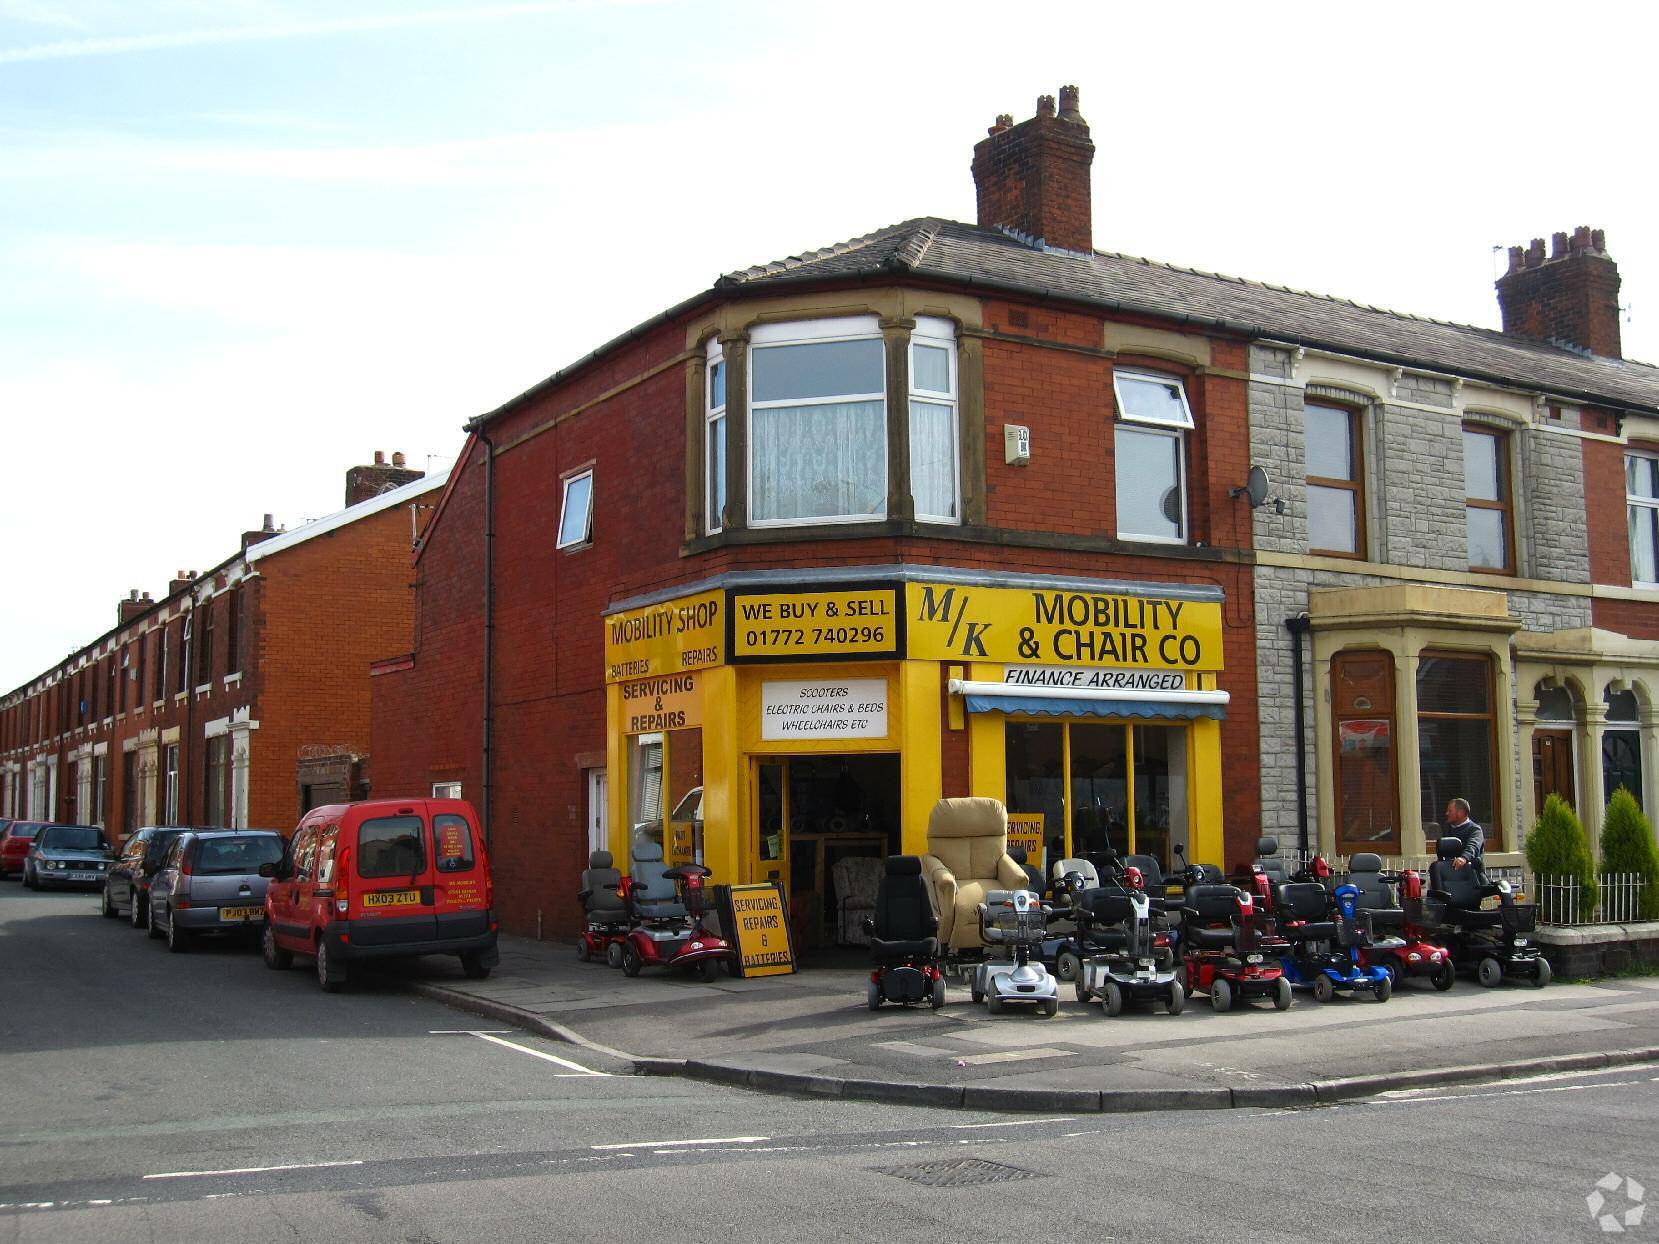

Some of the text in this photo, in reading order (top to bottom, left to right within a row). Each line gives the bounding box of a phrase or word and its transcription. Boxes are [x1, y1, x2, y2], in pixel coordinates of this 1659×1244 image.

[742, 599, 890, 621] WE BUY & SELL
[1033, 593, 1184, 631] MOBILITY
[611, 600, 718, 646] MOBILITY SHOP
[746, 626, 884, 646] 01772 740296
[1018, 627, 1201, 666] & CHAIR CO
[681, 646, 718, 667] REPAIRS
[611, 659, 649, 678] BATTERIES
[623, 675, 694, 700] SERVICING
[1005, 669, 1183, 690] FINANCE ARRANGED
[799, 687, 848, 698] SCOOTERS
[654, 696, 664, 711] &
[766, 702, 884, 715] ELECTRIC CHAIRS & BEDS
[631, 711, 686, 731] REPAIRS
[782, 719, 868, 731] WHEELCHAIRS ETC
[1007, 821, 1042, 835] ERVICING,
[397, 893, 416, 902] ZTU
[734, 897, 781, 912] SERVICING,
[743, 915, 779, 930] REPAIRS
